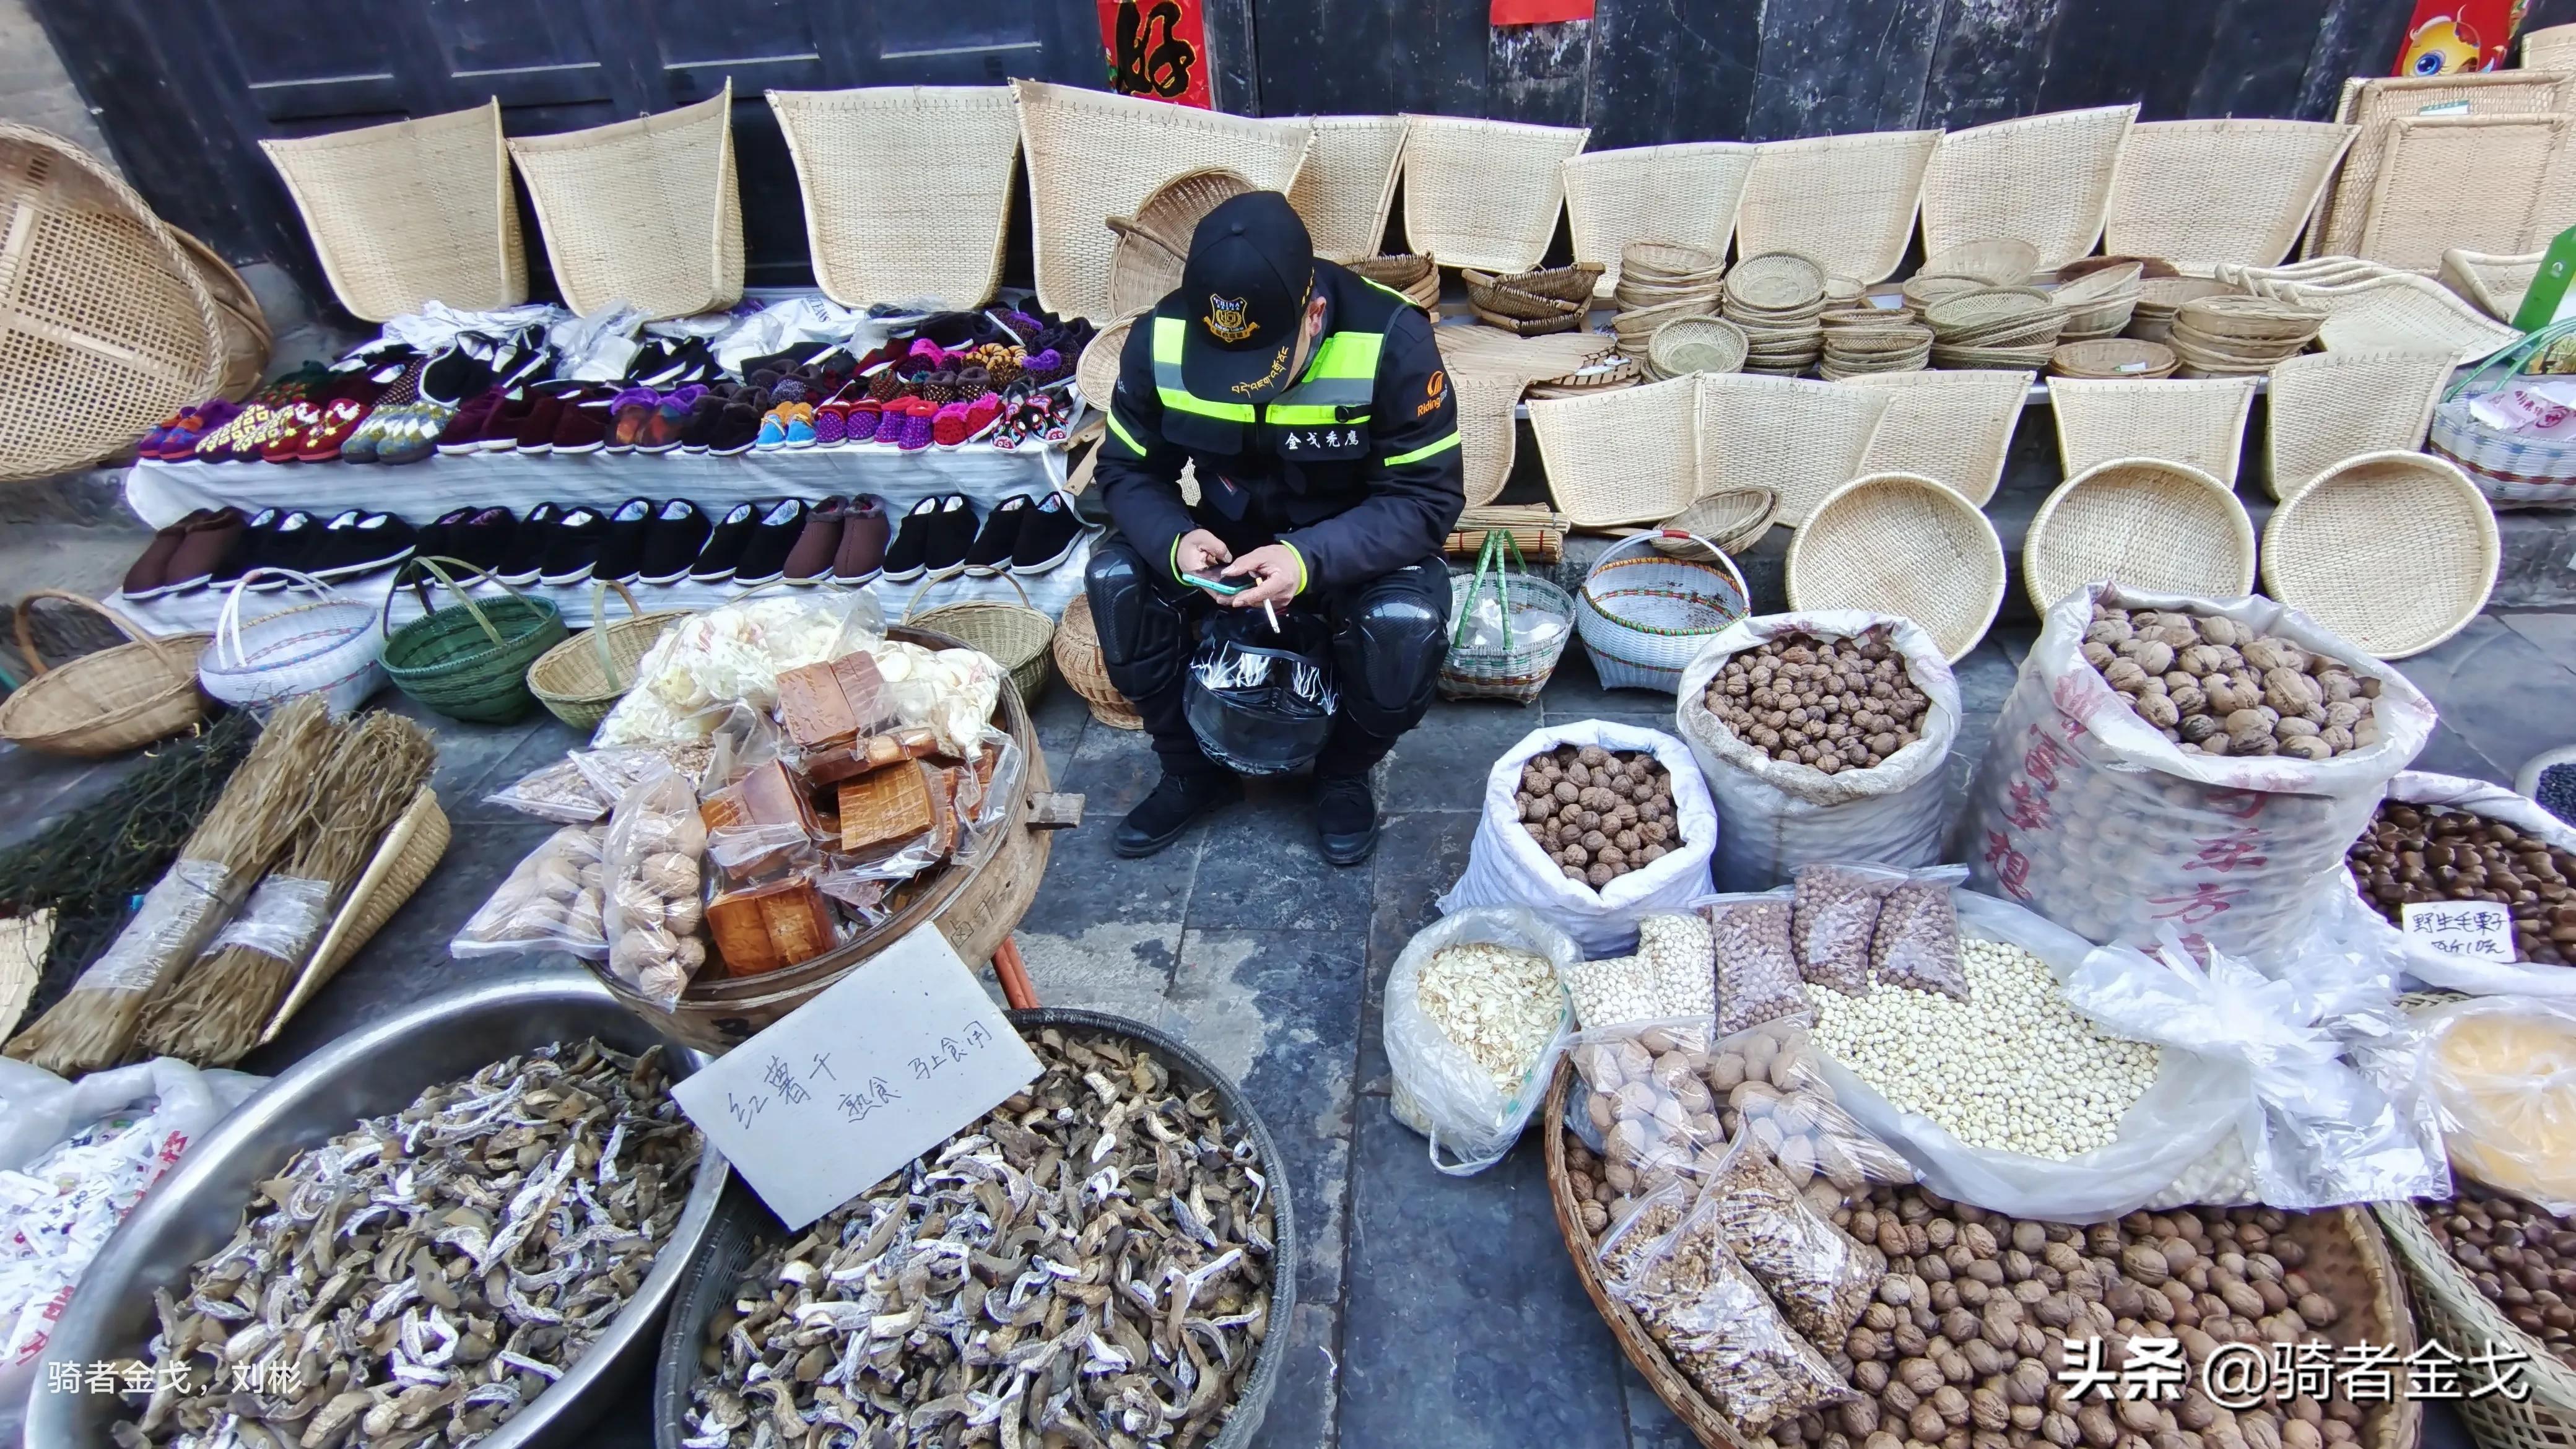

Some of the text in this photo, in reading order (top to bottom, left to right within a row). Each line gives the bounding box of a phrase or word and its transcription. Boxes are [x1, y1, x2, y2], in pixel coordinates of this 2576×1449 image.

[1285, 430, 1359, 450] 金戈秃鹰
[728, 1020, 992, 1130] 红薯干 熟食 马上食用
